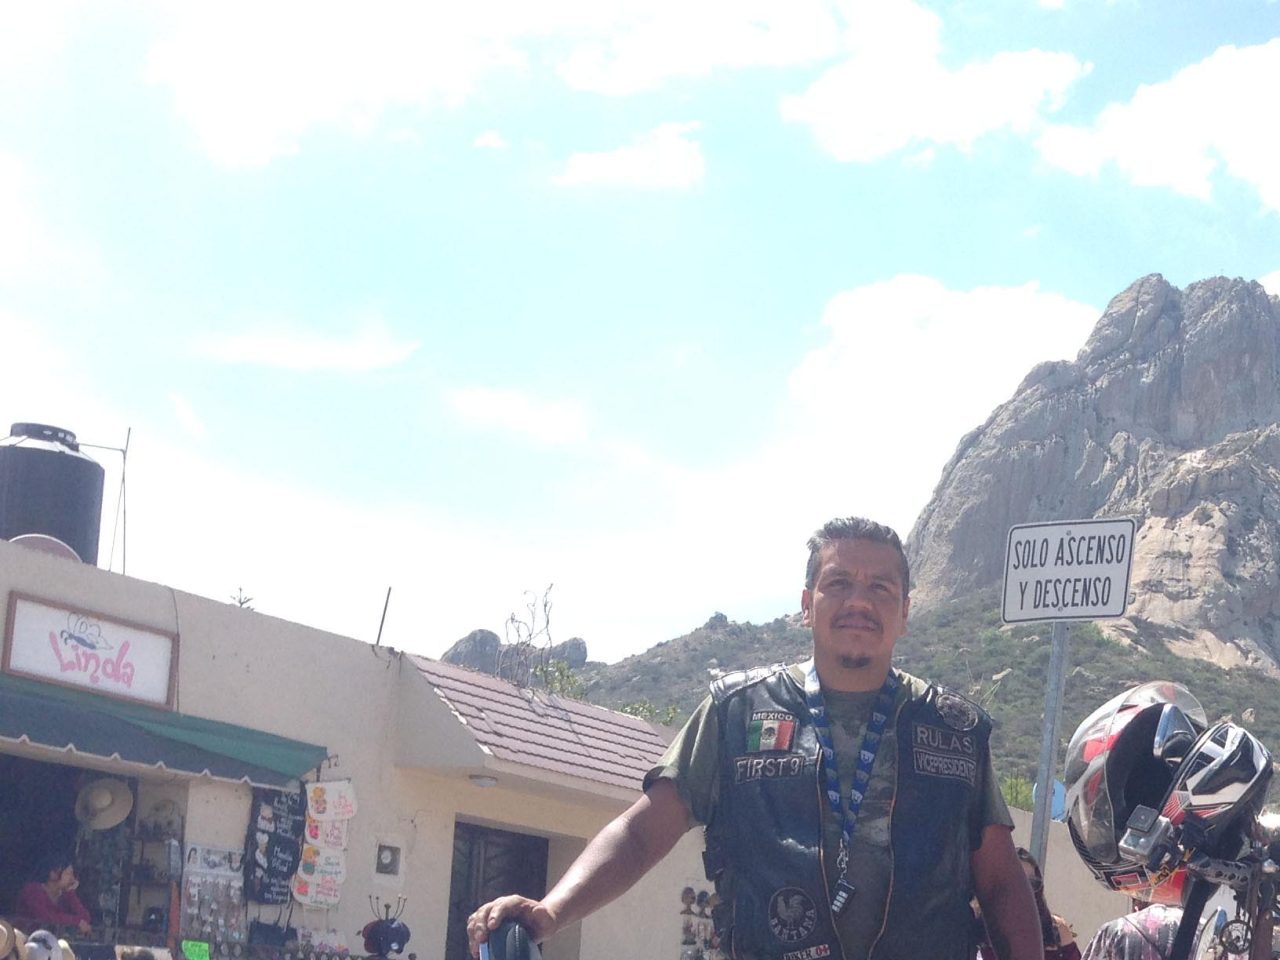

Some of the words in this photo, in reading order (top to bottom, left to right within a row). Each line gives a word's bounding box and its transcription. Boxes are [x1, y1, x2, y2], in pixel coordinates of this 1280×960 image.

[1013, 537, 1049, 570] SOLO
[1054, 534, 1126, 567] ASCENSO
[1019, 581, 1028, 610] Y
[1033, 576, 1111, 609] DESCENSO
[49, 631, 135, 688] Linda
[752, 712, 793, 721] MEXICO
[916, 727, 973, 753] RULAS
[737, 758, 788, 778] FIRST
